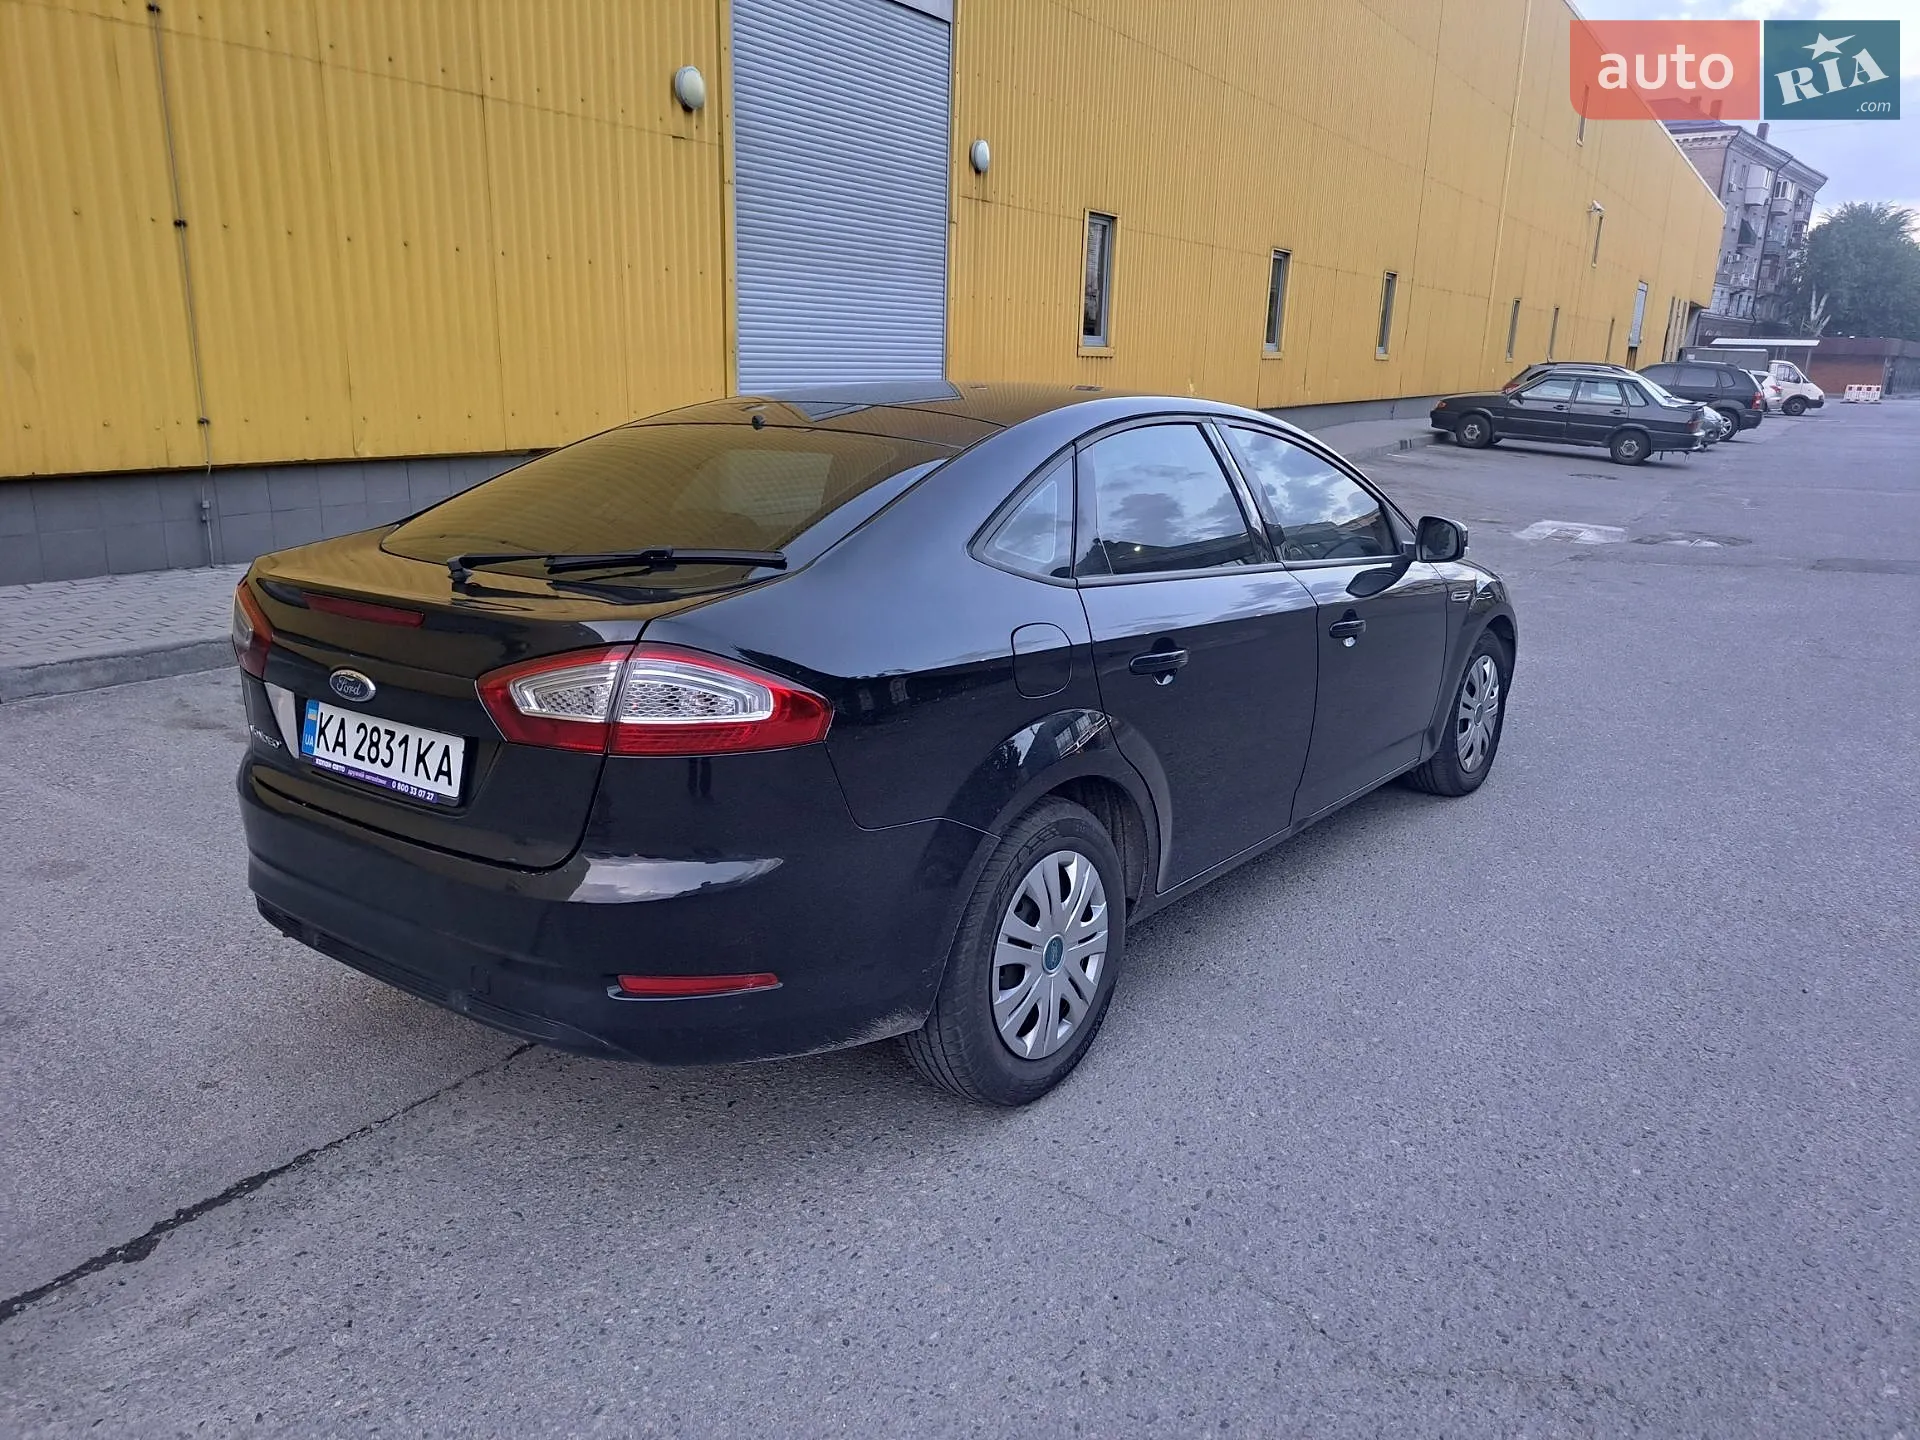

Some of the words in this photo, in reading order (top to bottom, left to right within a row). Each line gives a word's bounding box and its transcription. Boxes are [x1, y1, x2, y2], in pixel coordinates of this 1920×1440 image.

[337, 675, 360, 696] Ford
[304, 734, 314, 747] UA
[316, 711, 347, 757] KA
[353, 722, 410, 774] 2831
[414, 737, 453, 787] KA
[426, 791, 435, 801] 27
